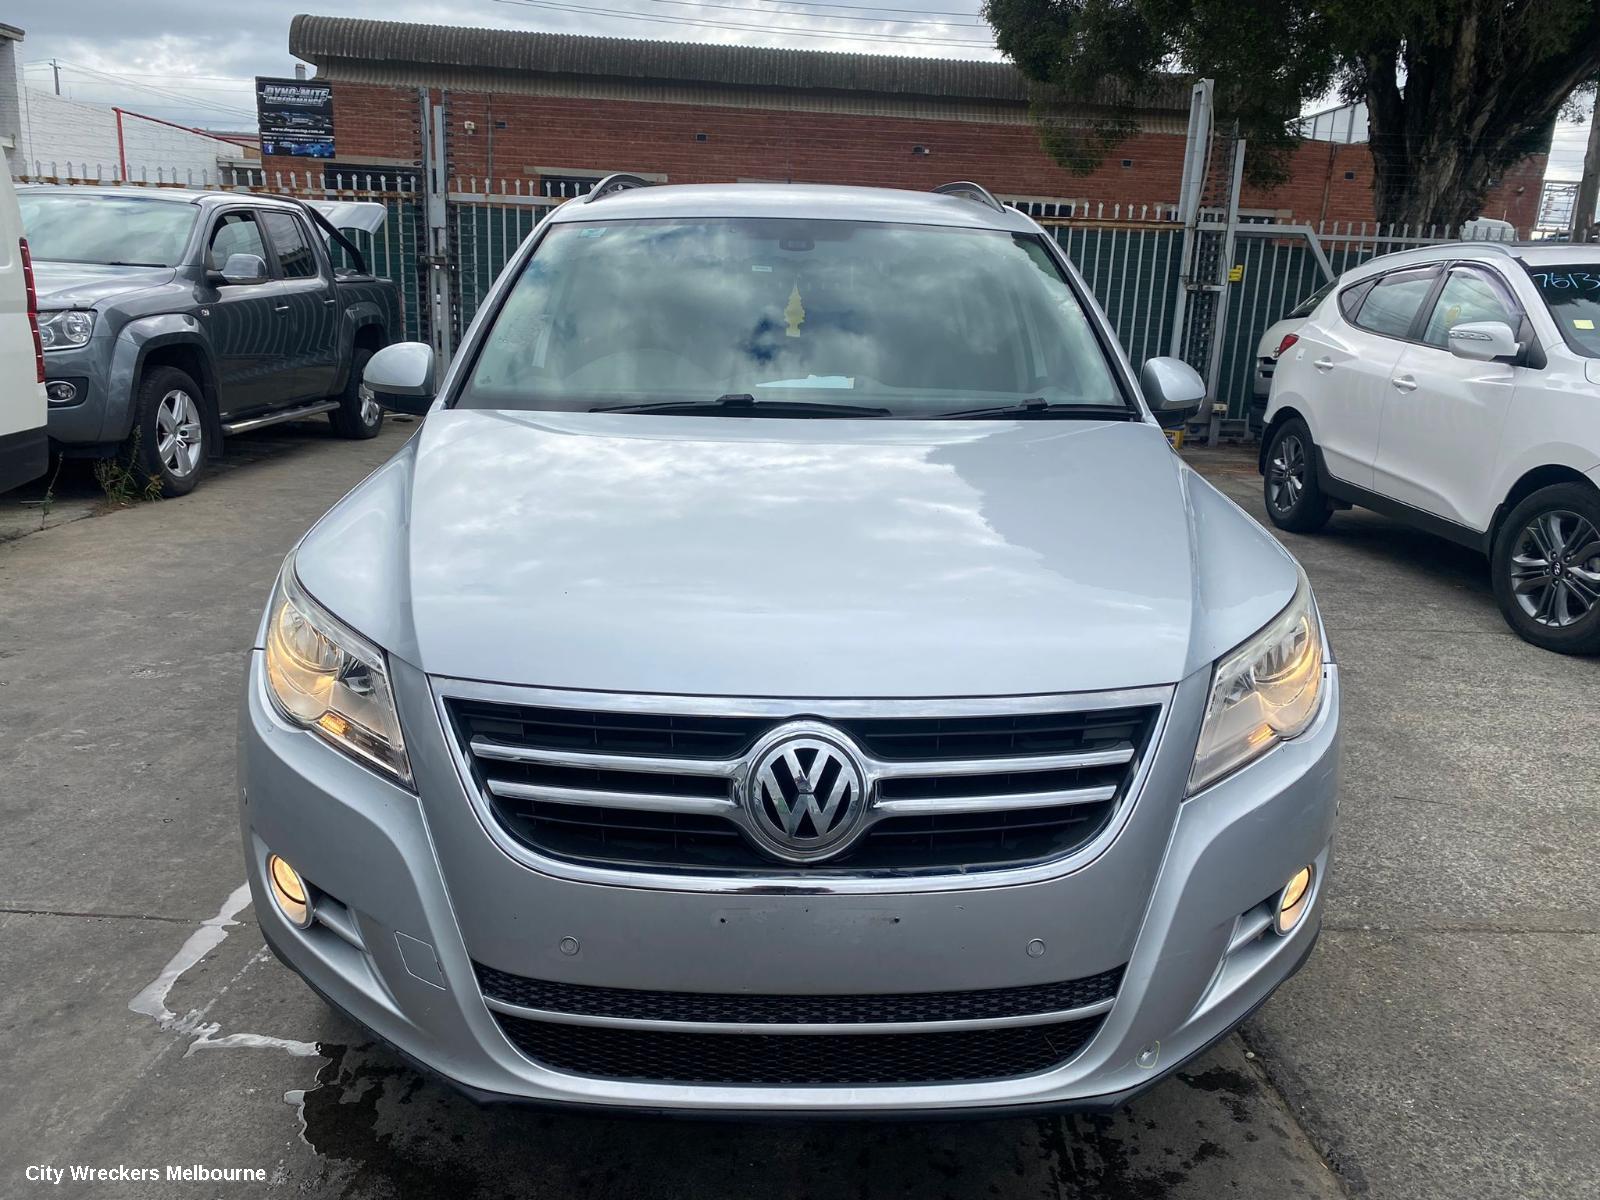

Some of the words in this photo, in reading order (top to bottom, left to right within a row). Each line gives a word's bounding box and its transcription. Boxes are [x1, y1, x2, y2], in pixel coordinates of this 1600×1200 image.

[265, 86, 328, 99] DYNO-MITE
[267, 96, 323, 105] PERFORMANCE
[756, 739, 860, 847] VW
